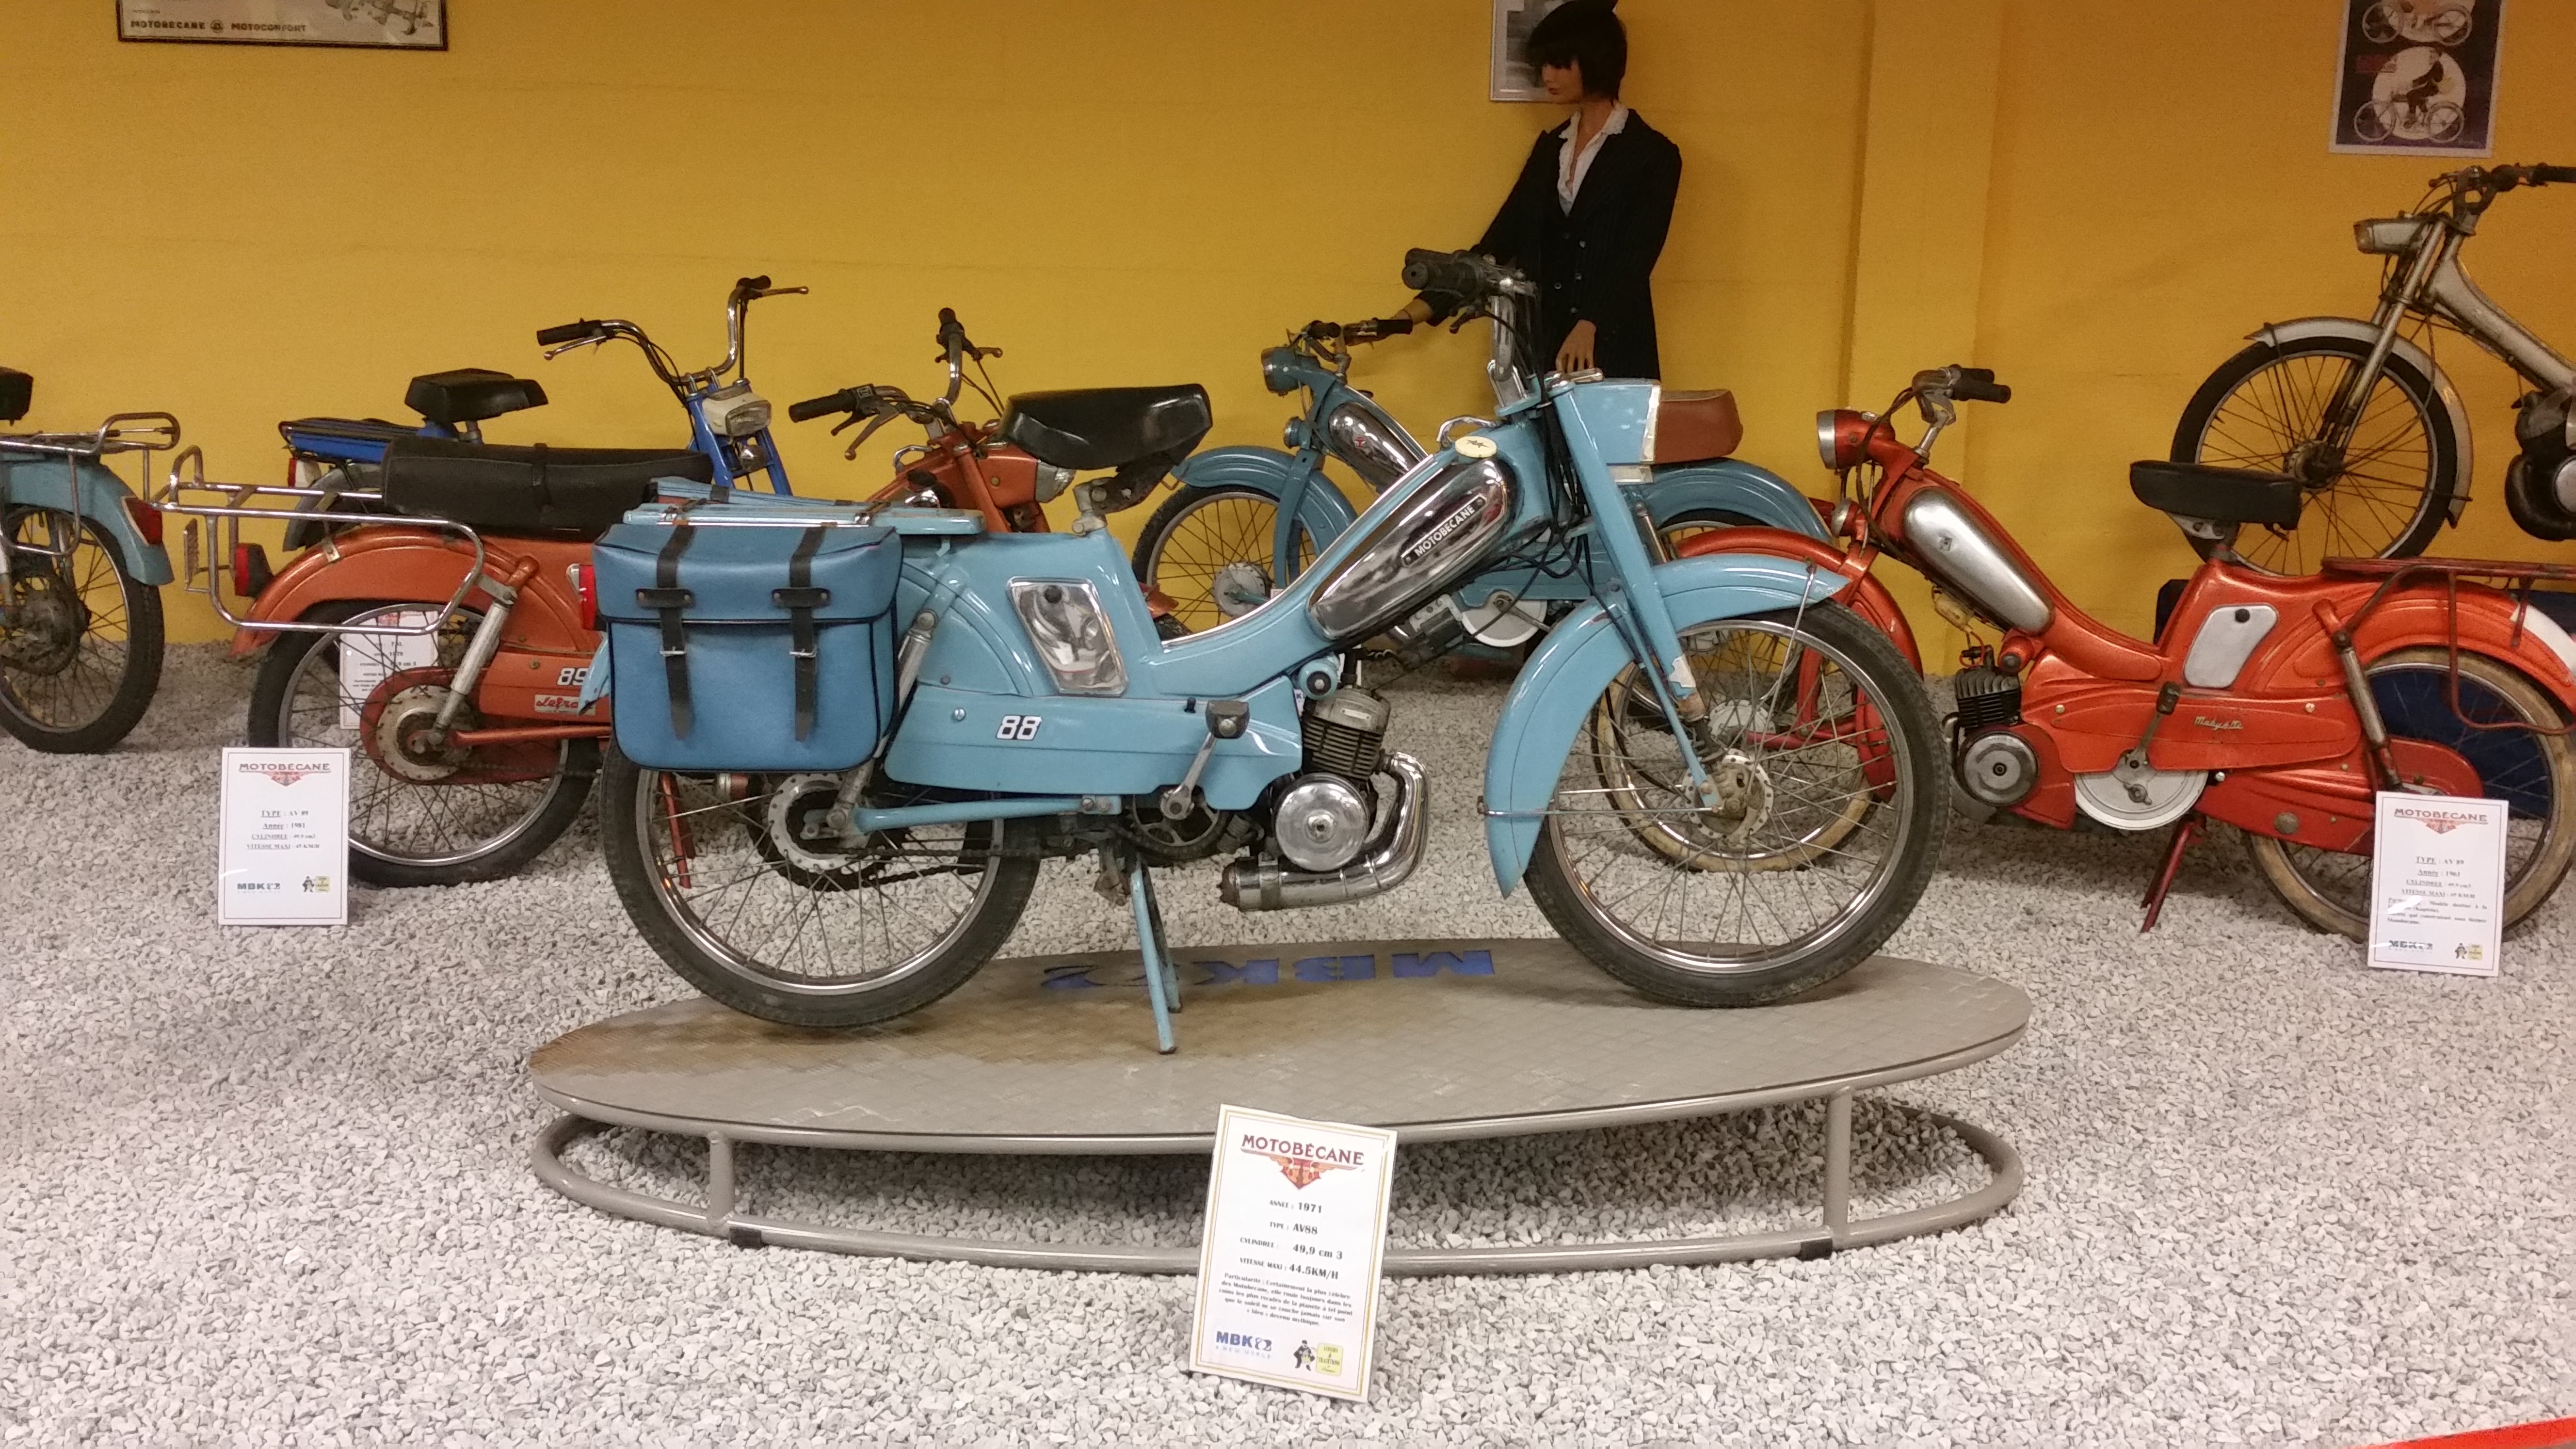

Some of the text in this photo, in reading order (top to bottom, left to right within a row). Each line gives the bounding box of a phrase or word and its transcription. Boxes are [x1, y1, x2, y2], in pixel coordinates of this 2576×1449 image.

[1414, 505, 1475, 557] MOTOBECANE
[997, 715, 1042, 740] 88
[1298, 1202, 1322, 1213] 1971
[1270, 1221, 1284, 1229] TYPE
[1293, 1223, 1318, 1235] AV88
[1293, 1243, 1315, 1255] 49,9
[1319, 1250, 1333, 1258] cm
[1336, 1251, 1343, 1259] 3
[1267, 1261, 1283, 1270] MAXI
[1289, 1263, 1338, 1280] 44.5KM/H
[1300, 1294, 1325, 1303] toujours
[1270, 1312, 1290, 1321] devenu
[1216, 1331, 1253, 1348] MBK
